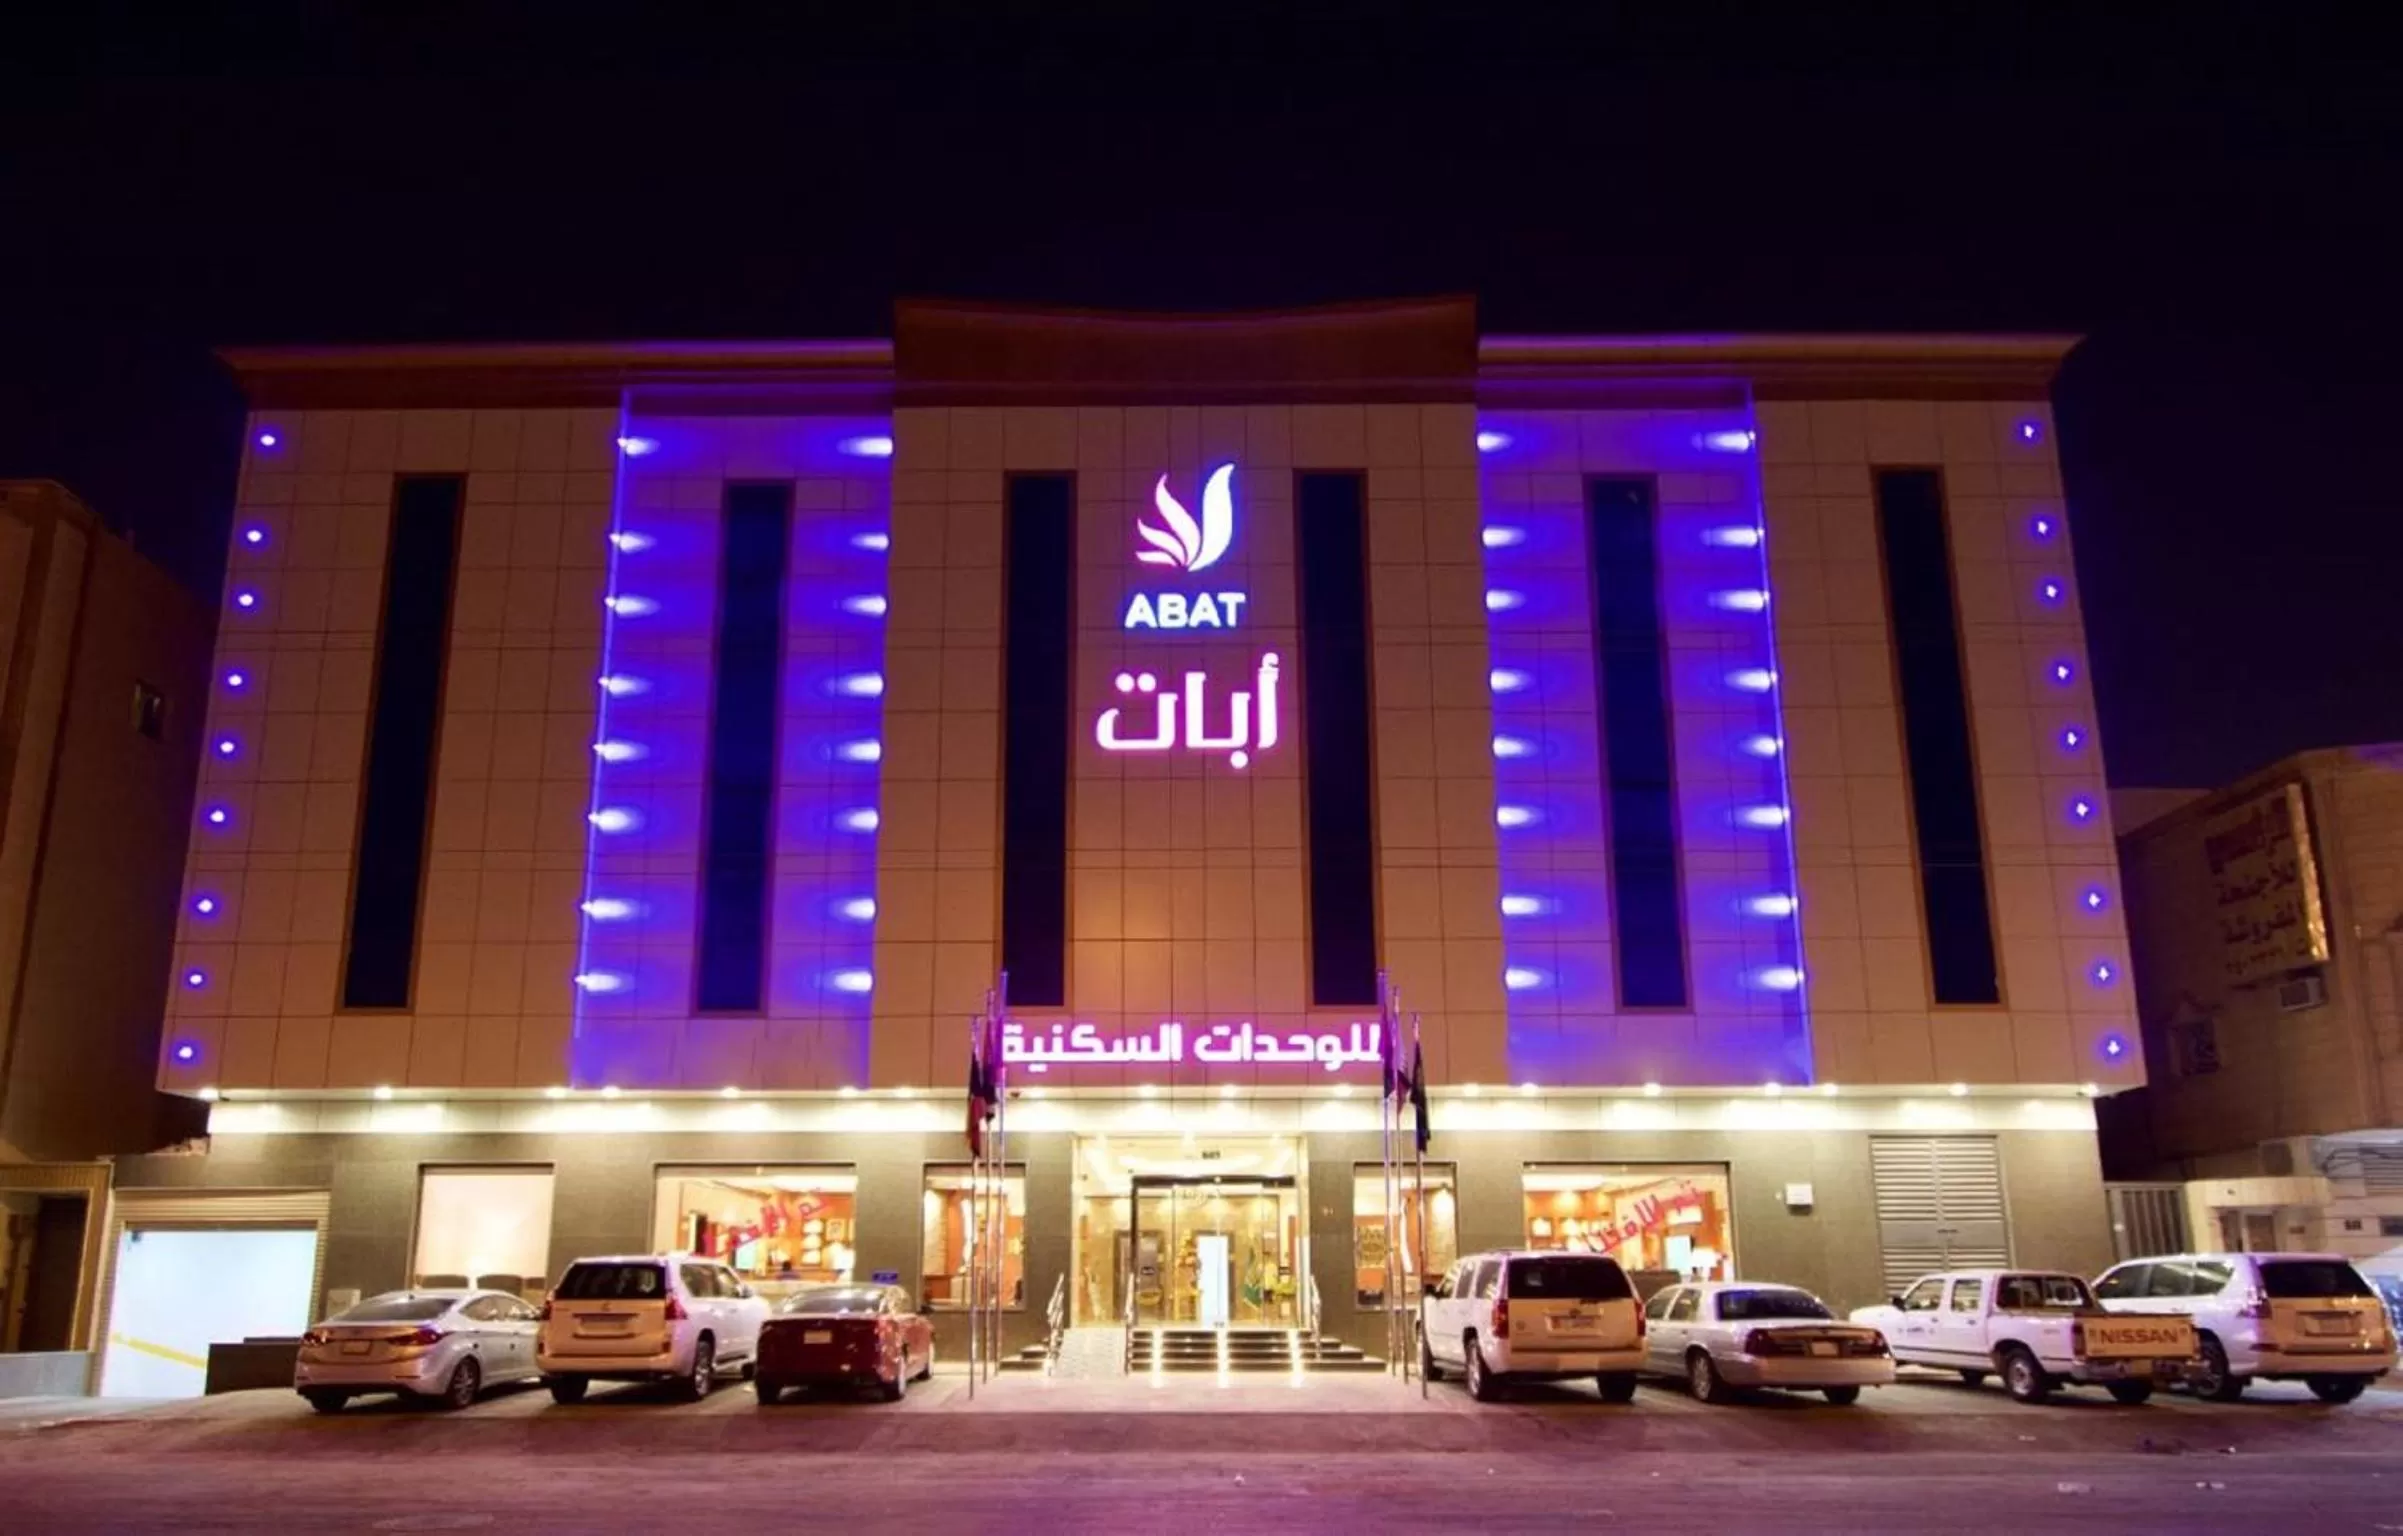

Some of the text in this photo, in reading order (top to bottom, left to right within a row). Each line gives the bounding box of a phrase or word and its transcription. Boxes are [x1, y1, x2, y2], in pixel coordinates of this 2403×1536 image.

[1125, 592, 1246, 628] ABAT
[1096, 652, 1280, 770] أبات
[1002, 1022, 1384, 1072] للوحدات السكنية
[2100, 1327, 2179, 1345] NISSAN
